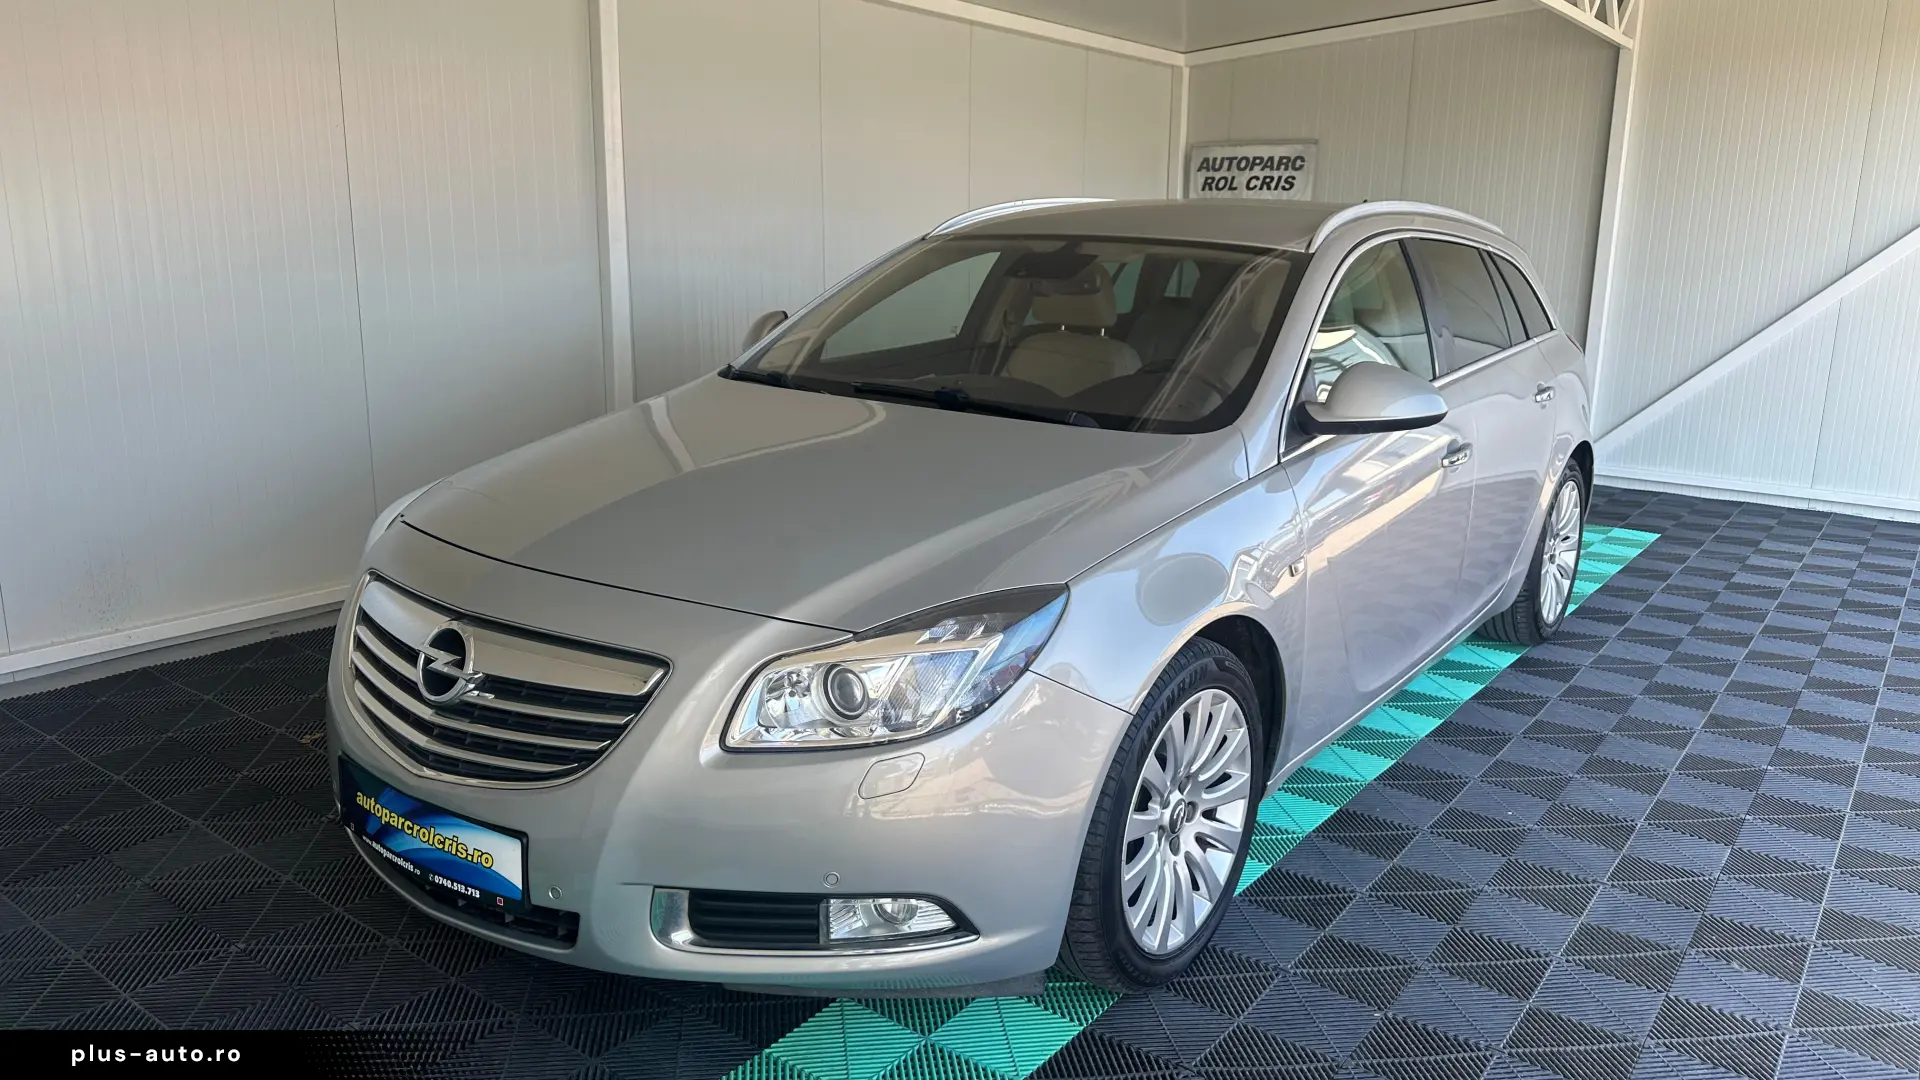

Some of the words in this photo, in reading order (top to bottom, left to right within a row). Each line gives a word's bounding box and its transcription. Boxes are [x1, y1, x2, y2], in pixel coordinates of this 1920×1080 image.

[1197, 156, 1305, 172] AUTOPARC
[1201, 176, 1238, 191] ROL
[1245, 175, 1296, 191] CRIS
[355, 791, 494, 869] autoparcrolcris.ro
[434, 875, 480, 898] 0740.513.713
